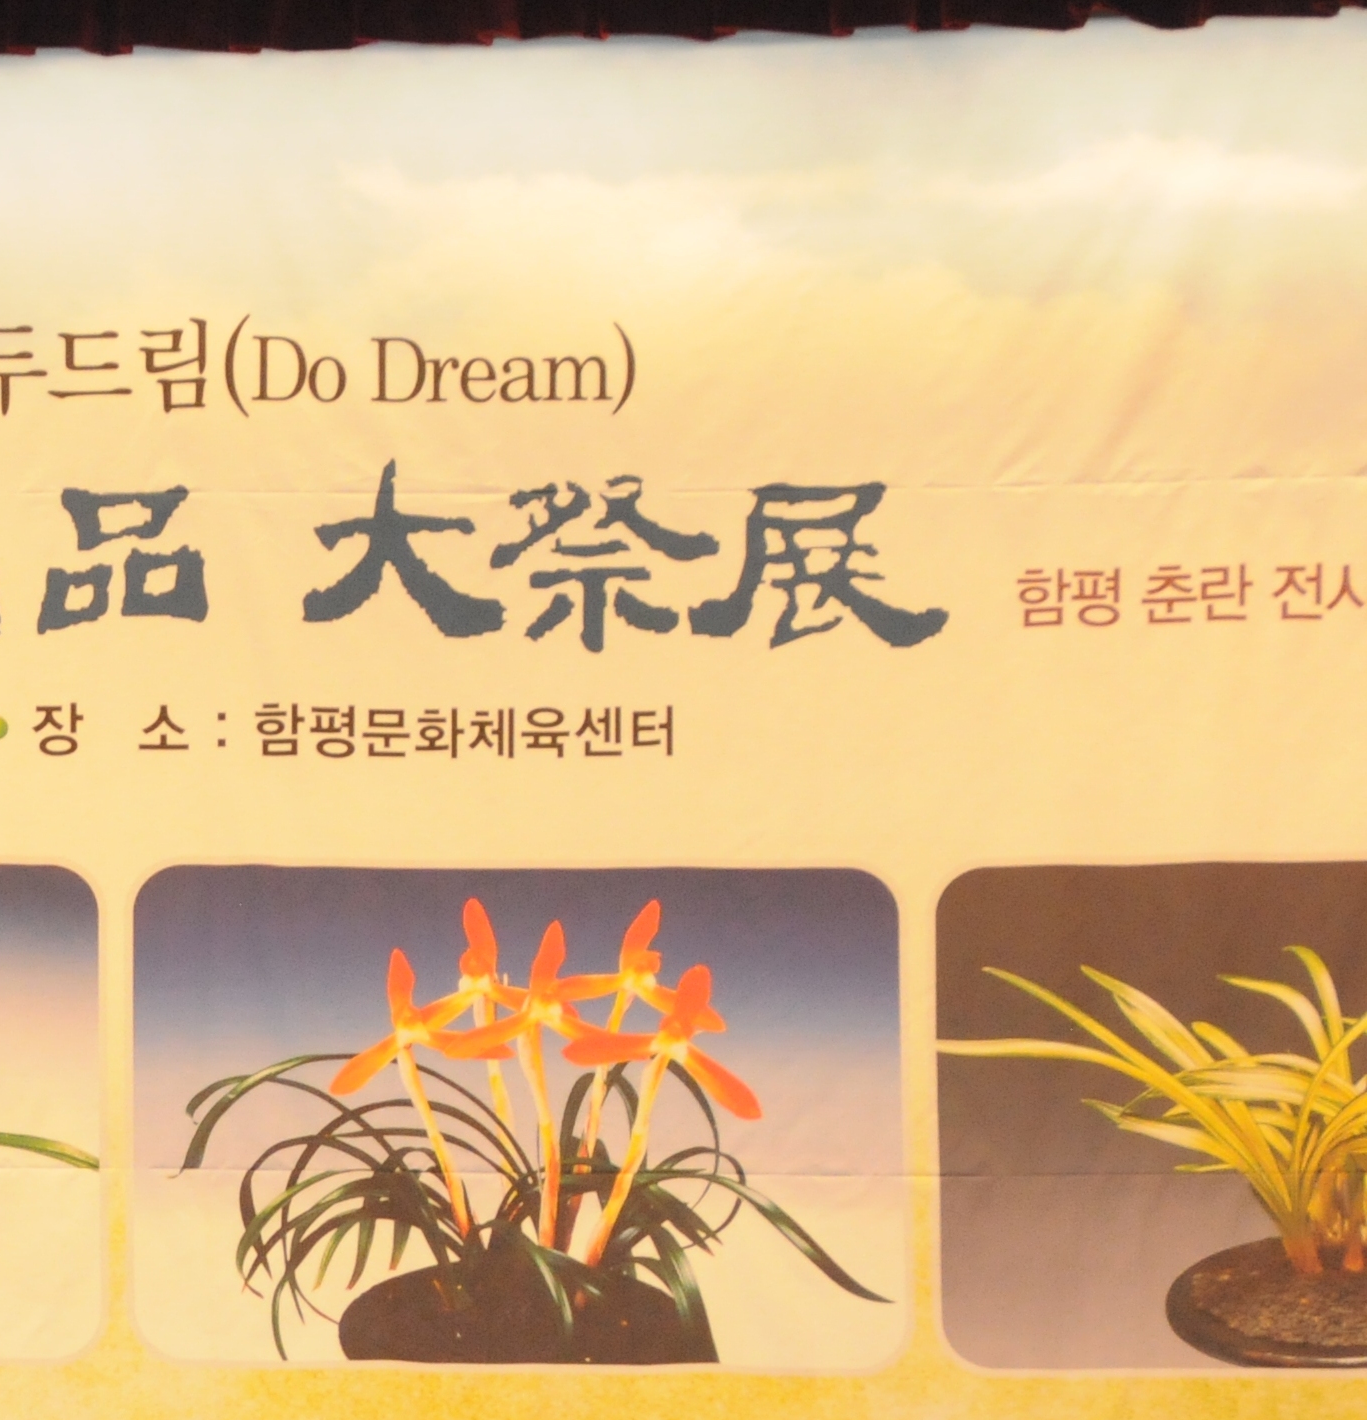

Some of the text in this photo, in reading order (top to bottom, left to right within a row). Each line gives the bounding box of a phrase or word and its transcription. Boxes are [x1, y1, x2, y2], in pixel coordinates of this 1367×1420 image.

[371, 322, 636, 416] Dream)
[1016, 567, 1121, 628] 함평
[1141, 563, 1254, 624] 춘란
[254, 703, 673, 759] 함평문화체육센터
